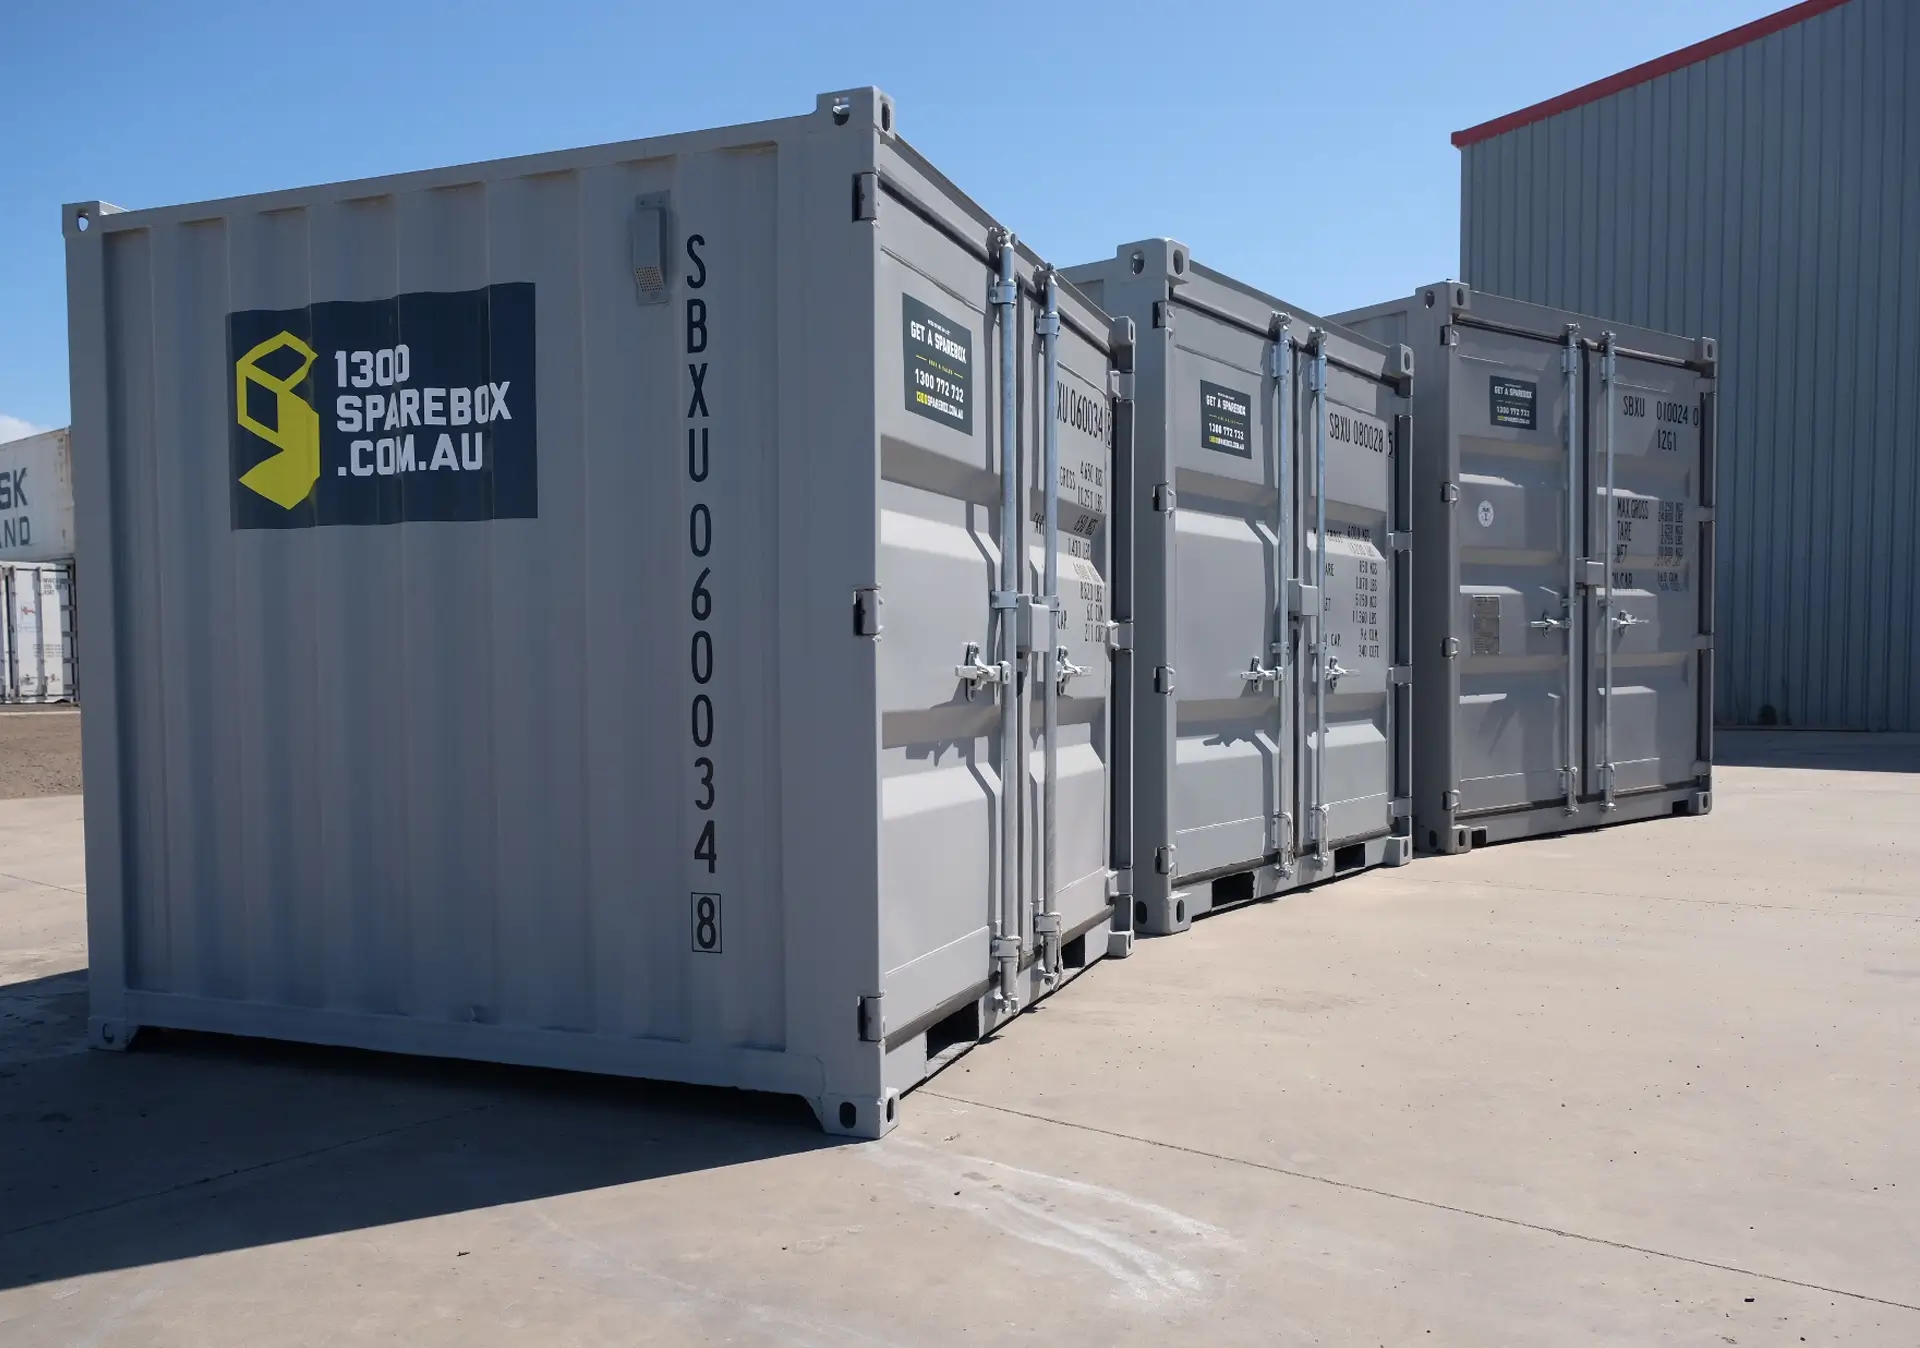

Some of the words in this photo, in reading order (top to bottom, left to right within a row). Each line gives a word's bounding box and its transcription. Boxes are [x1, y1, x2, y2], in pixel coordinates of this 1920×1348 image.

[686, 233, 711, 484] SBXU
[910, 320, 925, 342] GET
[928, 329, 932, 346] A
[934, 332, 966, 364] SPAREBOX
[335, 344, 410, 388] 1300
[915, 368, 934, 390] 1300
[936, 377, 950, 397] 772
[951, 384, 964, 403] 732
[336, 381, 512, 432] SPAREBOX
[1206, 394, 1216, 407] GET
[1217, 398, 1221, 408] A
[1494, 386, 1504, 395] GET
[1623, 396, 1645, 418] SBXU
[1656, 401, 1688, 424] 010024
[1692, 407, 1698, 426] 0
[1070, 389, 1103, 442] 060034
[1330, 412, 1350, 443] SBXU
[1353, 420, 1384, 453] 080028
[337, 432, 483, 477] .COM.AU
[1657, 429, 1676, 452] 12G1
[0, 516, 31, 549] ND
[1617, 520, 1632, 541] TARE
[689, 503, 718, 875] 060034
[697, 894, 716, 950] 8
